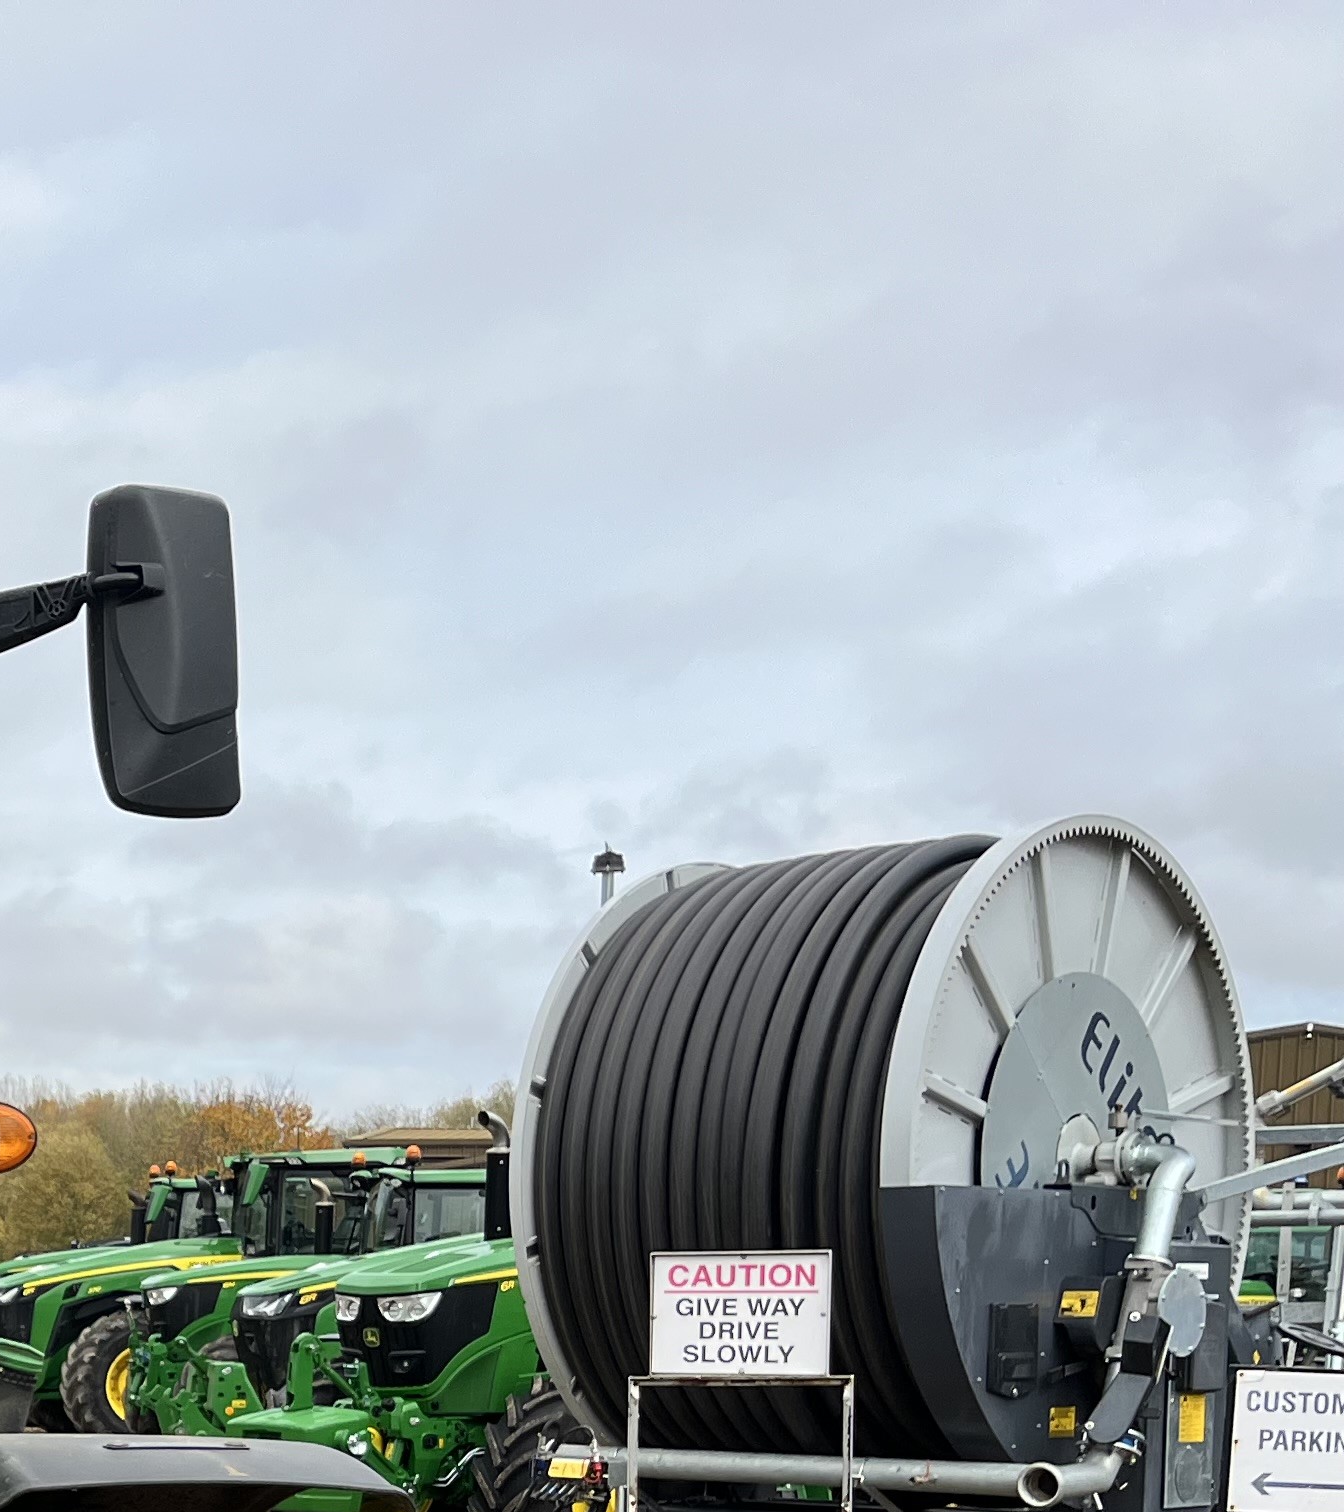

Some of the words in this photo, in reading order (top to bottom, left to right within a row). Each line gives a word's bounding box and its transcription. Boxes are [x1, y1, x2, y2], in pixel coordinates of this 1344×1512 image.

[1081, 1011, 1155, 1143] Elit
[667, 1264, 816, 1287] CAUTION
[675, 1298, 738, 1316] GIVE
[747, 1298, 805, 1316] WAY
[699, 1321, 779, 1340] DRIVE
[682, 1345, 794, 1363] SLOWLY
[1246, 1389, 1344, 1415] CUSTOM
[1258, 1429, 1344, 1453] PARKIN
